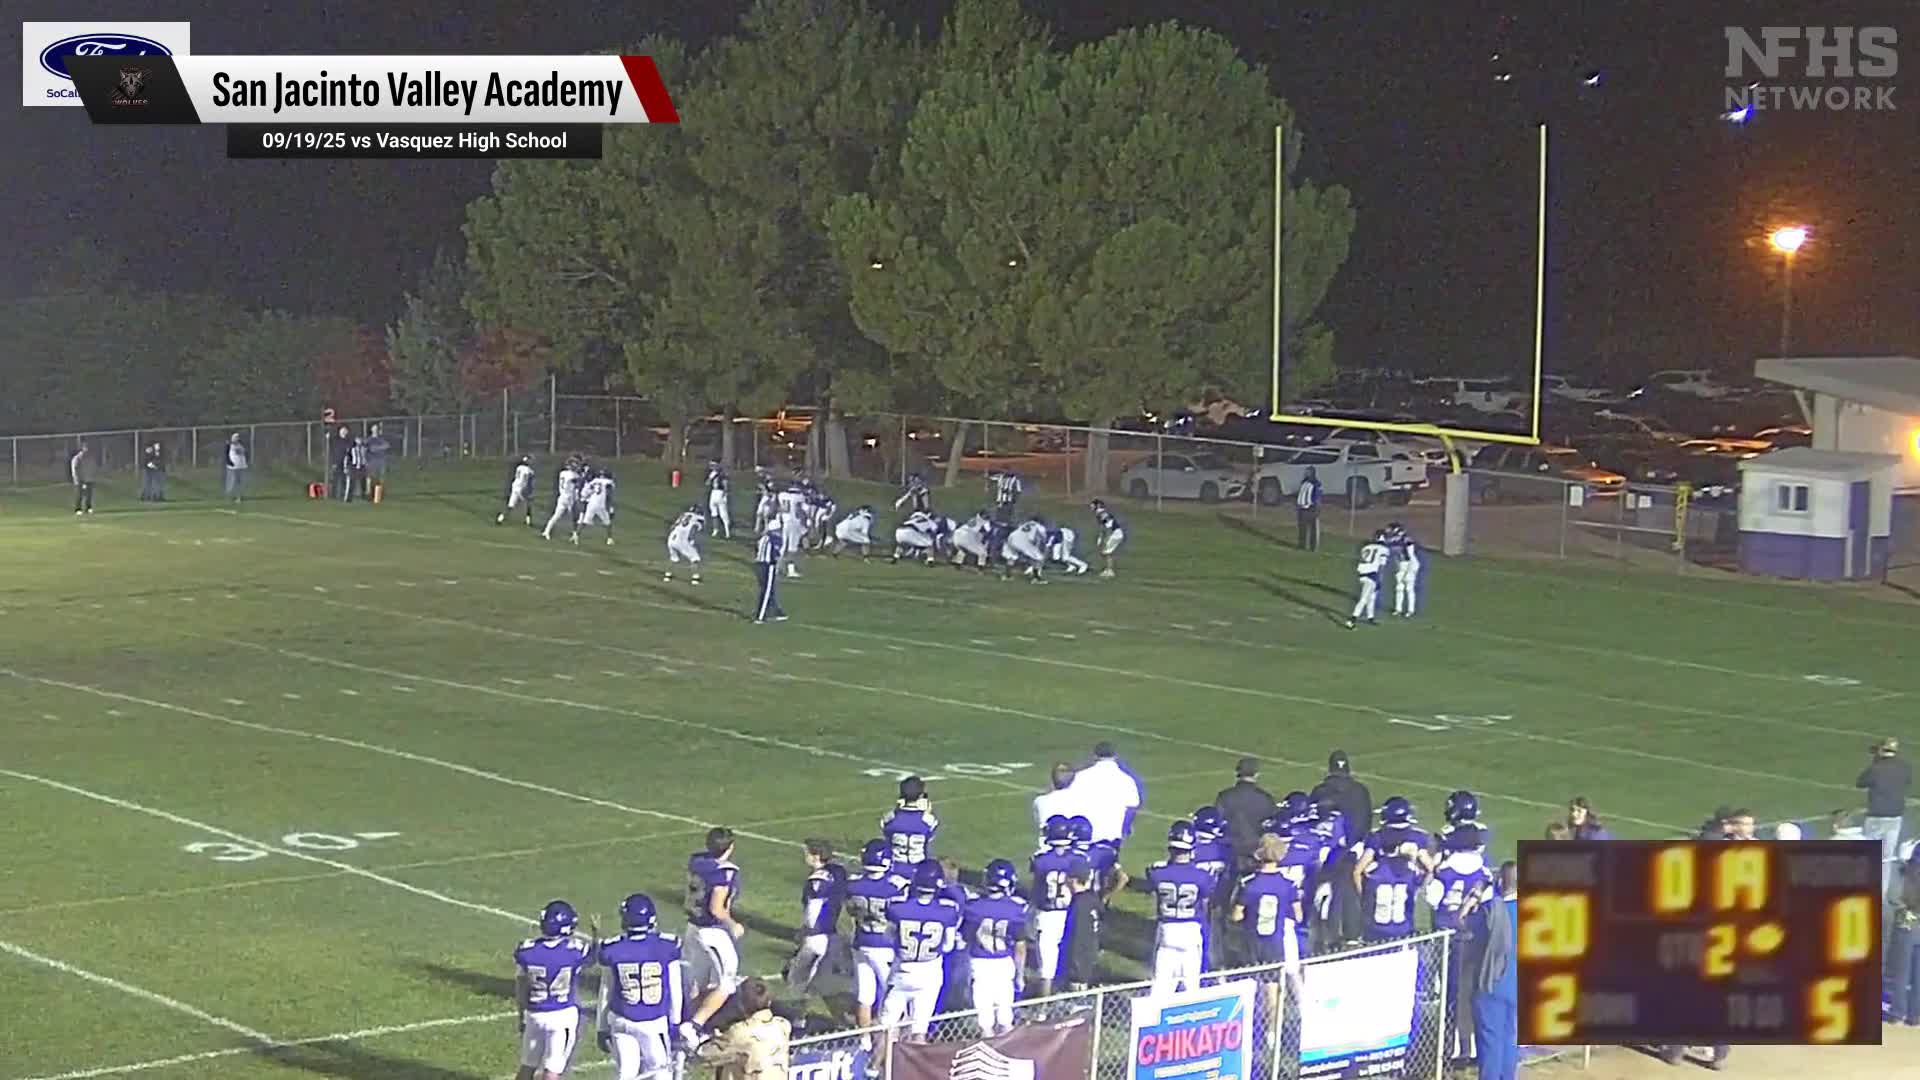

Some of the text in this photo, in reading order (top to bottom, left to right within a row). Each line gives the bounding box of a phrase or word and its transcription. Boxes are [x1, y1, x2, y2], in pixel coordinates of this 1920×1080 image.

[181, 832, 359, 862] 30
[1158, 882, 1198, 918] 22
[900, 919, 944, 962] 52
[1518, 892, 1589, 958] 20
[1831, 894, 1873, 962] 0
[1704, 923, 1737, 977] 2
[526, 964, 573, 1003] 54
[616, 961, 663, 1005] 56
[1533, 973, 1578, 1039] 2
[1809, 975, 1851, 1043] 5
[1137, 1020, 1243, 1066] CHIKATO
